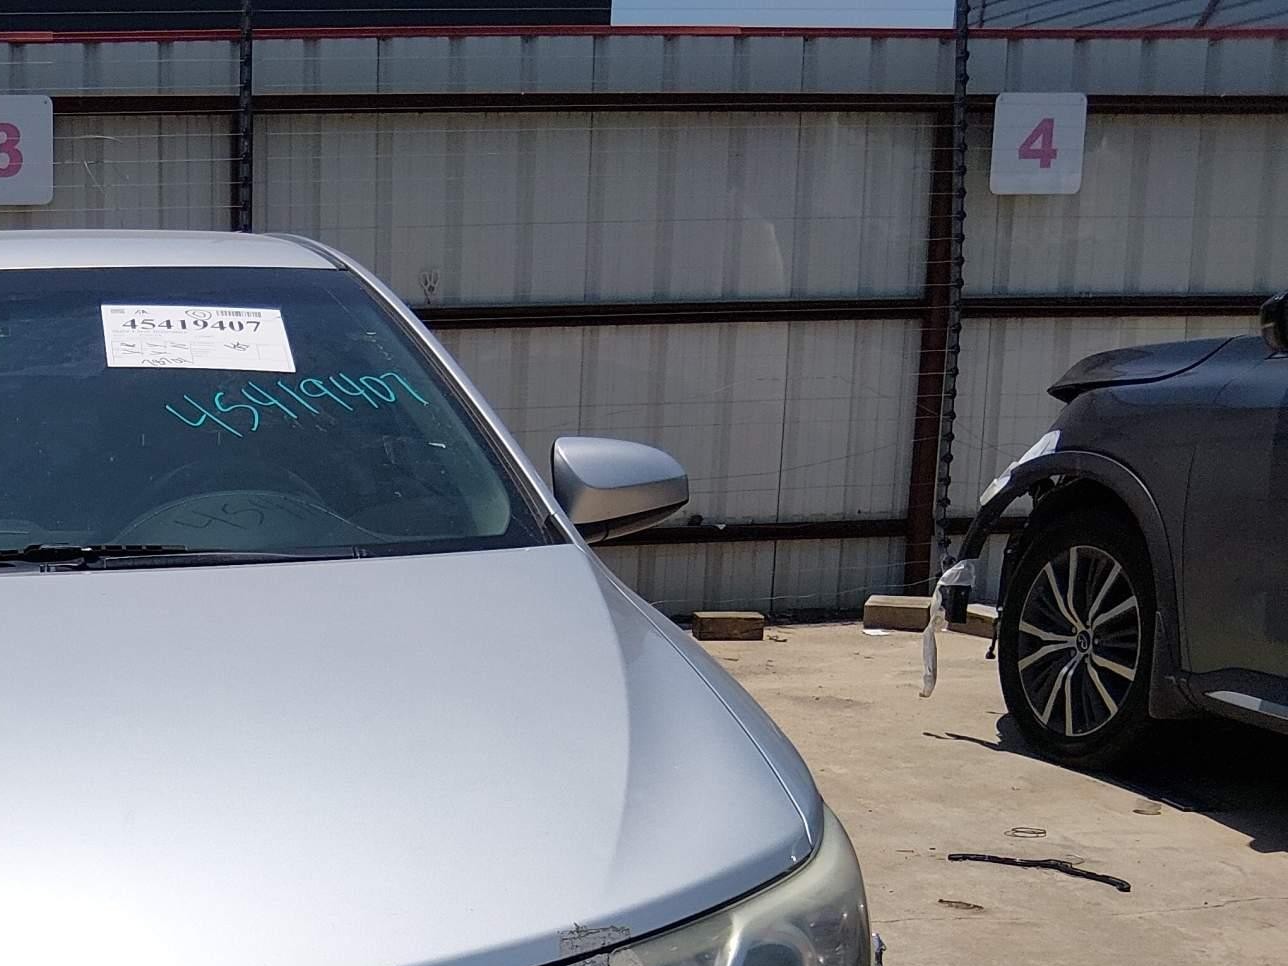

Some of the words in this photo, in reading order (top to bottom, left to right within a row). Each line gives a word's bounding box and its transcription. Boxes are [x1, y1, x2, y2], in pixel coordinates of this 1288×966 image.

[1018, 118, 1057, 169] 4
[122, 318, 261, 333] 45419407
[165, 372, 429, 438] 45419407
